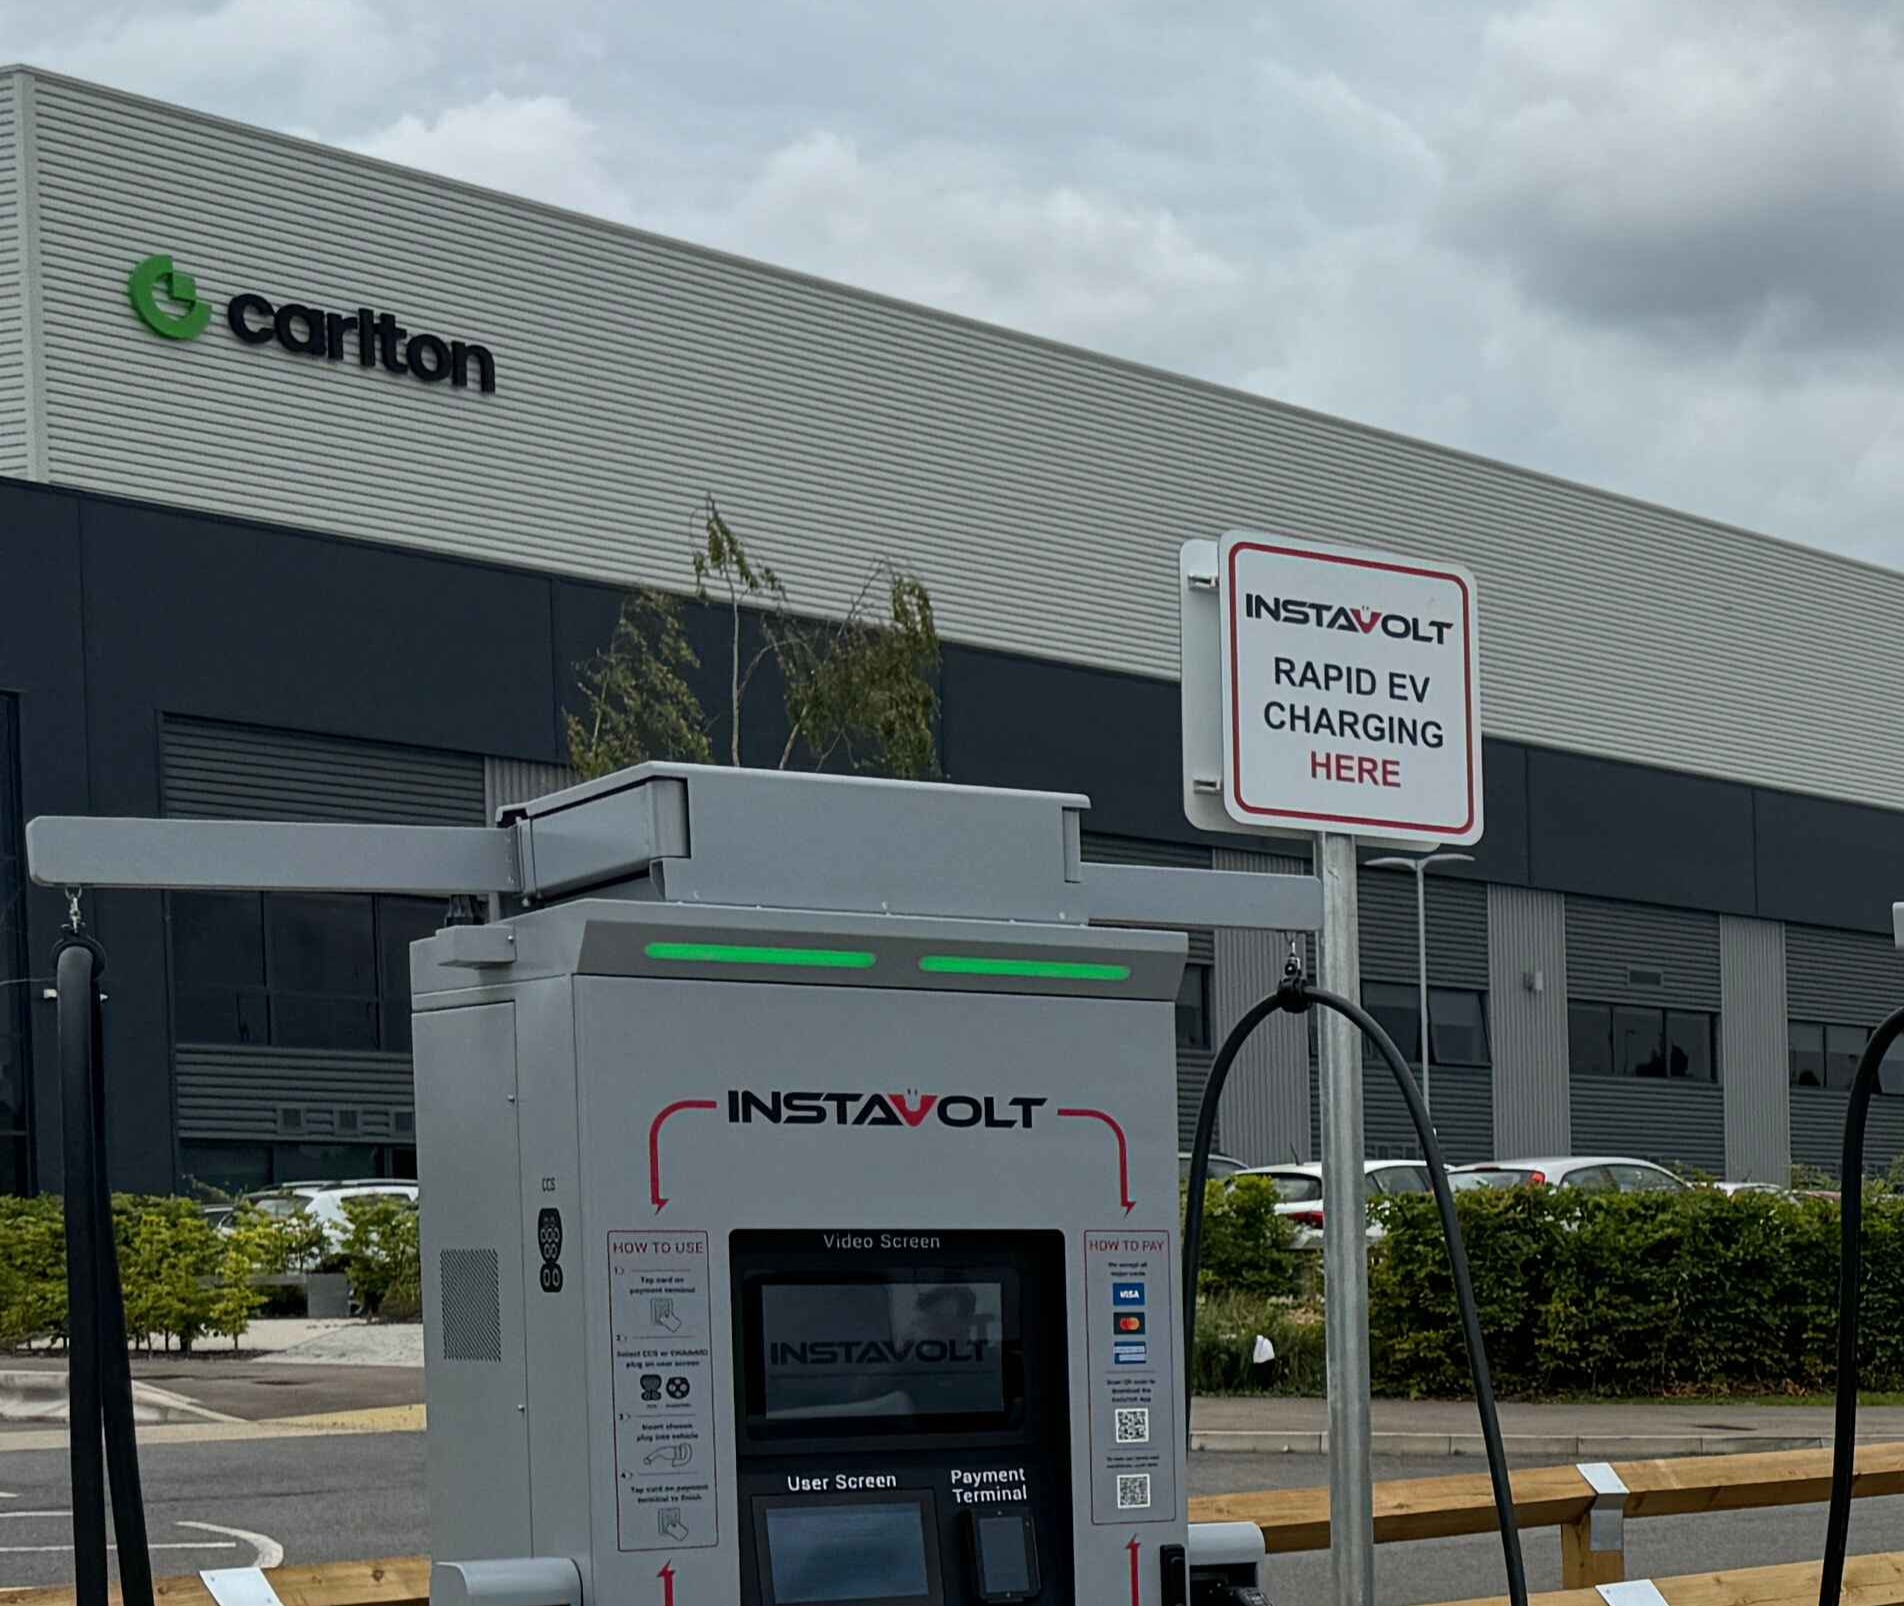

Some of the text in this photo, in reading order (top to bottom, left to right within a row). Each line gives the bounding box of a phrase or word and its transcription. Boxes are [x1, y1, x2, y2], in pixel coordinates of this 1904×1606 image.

[228, 294, 496, 393] carlton
[1245, 593, 1454, 645] INSTAVOLT
[1274, 657, 1430, 703] RAPID EV
[1264, 701, 1444, 748] CHARGING
[1310, 751, 1402, 788] HERE
[728, 1089, 1048, 1129] INSTAVOLT
[541, 1177, 556, 1192] CCS
[613, 1241, 704, 1254] HOW TO USE
[822, 1233, 941, 1249] Video Screen
[1089, 1240, 1165, 1252] HOW TO PAY
[1119, 1290, 1140, 1299] VISA
[769, 1340, 988, 1366] INSTAVOLT
[787, 1470, 897, 1492] User Screen
[950, 1466, 1026, 1488] Payment
[952, 1485, 1028, 1504] Terminal
